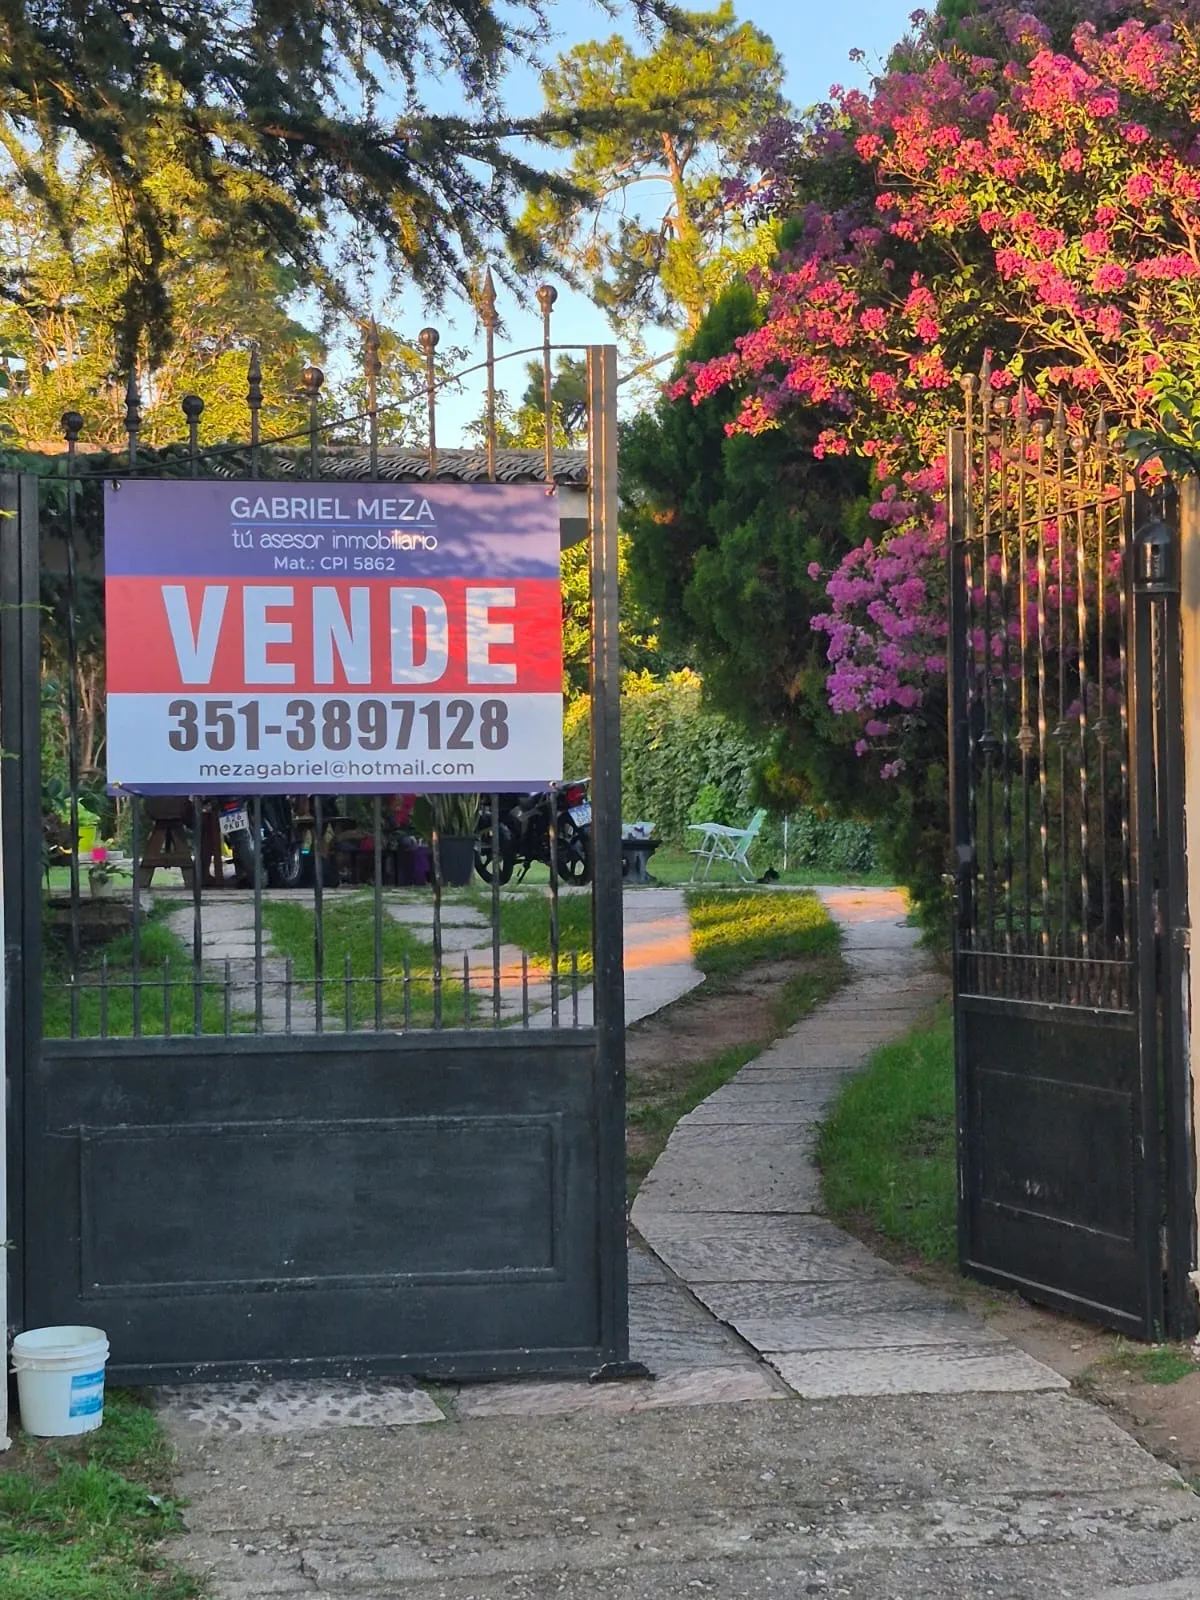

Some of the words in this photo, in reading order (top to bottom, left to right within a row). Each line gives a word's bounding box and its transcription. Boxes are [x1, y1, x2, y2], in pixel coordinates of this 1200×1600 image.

[230, 496, 350, 520] GABRIEL
[357, 498, 435, 521] MEZA
[231, 529, 254, 549] tú
[259, 533, 325, 549] asesor
[332, 528, 438, 550] inmobiliario
[274, 556, 315, 570] Mat.:
[320, 556, 348, 570] CPI
[353, 557, 396, 571] 5862
[161, 585, 518, 685] VENDE
[168, 699, 510, 751] 351-3897128
[199, 759, 475, 780] mezagabriel@hotmail.com
